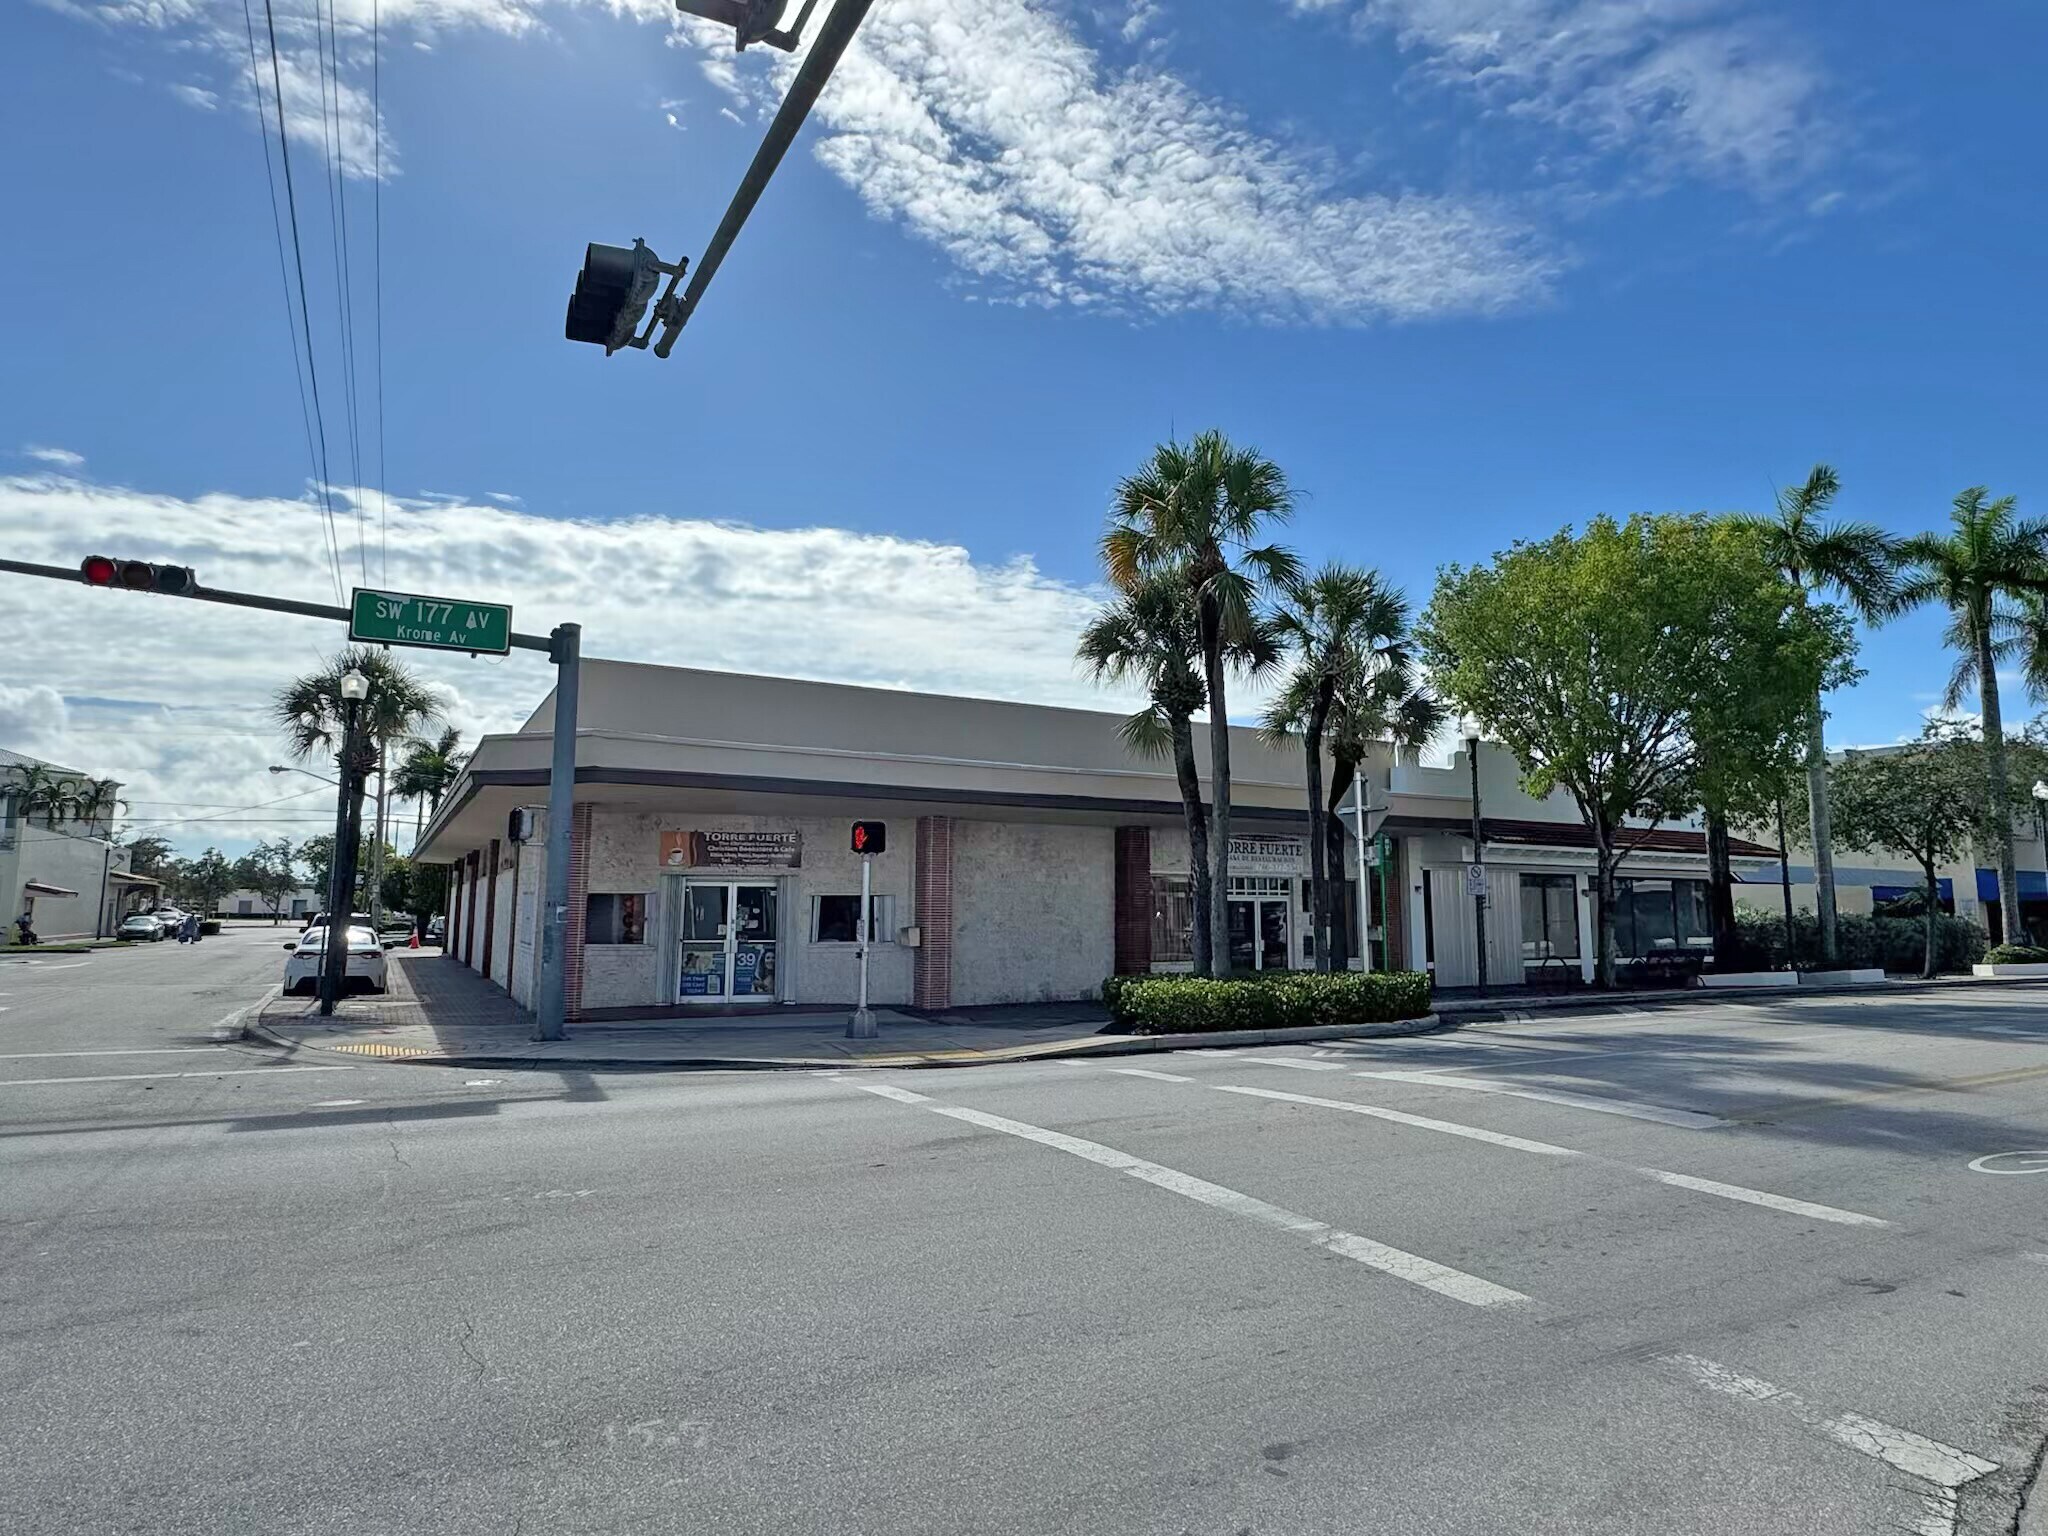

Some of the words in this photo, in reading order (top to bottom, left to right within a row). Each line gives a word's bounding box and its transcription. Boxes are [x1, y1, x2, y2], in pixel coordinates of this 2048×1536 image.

[375, 600, 403, 620] SW
[416, 601, 454, 625] 177
[465, 610, 490, 630] AV
[396, 624, 442, 642] Krome
[449, 630, 467, 644] Av
[704, 832, 745, 841] TORRE
[748, 833, 796, 842] FUERTE
[1228, 842, 1256, 854] ORRE
[1260, 844, 1303, 856] FUERTE
[737, 952, 756, 966] 39
